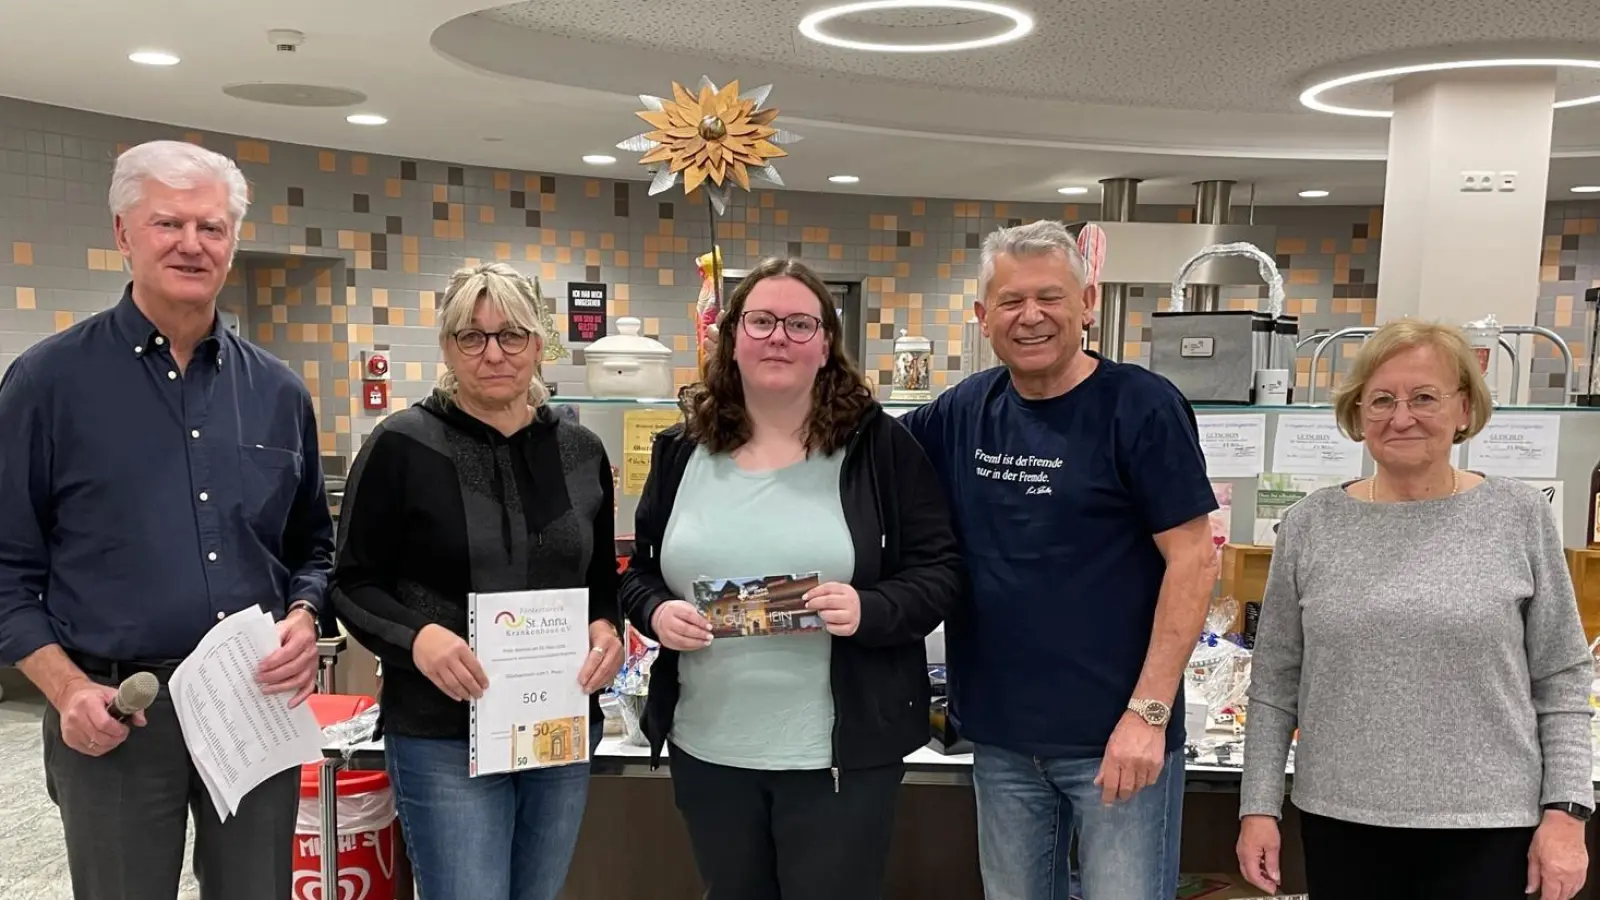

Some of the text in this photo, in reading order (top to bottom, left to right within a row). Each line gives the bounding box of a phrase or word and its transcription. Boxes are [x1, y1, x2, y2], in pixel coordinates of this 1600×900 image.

[1002, 454, 1014, 465] ist
[1028, 456, 1063, 469] Fremde
[975, 466, 1050, 483] nur in der Fremde.
[526, 617, 567, 628] St. Anna
[722, 611, 793, 626] GUTHEIN
[522, 691, 548, 704] 50 €
[533, 722, 550, 737] 50
[517, 756, 528, 766] 50
